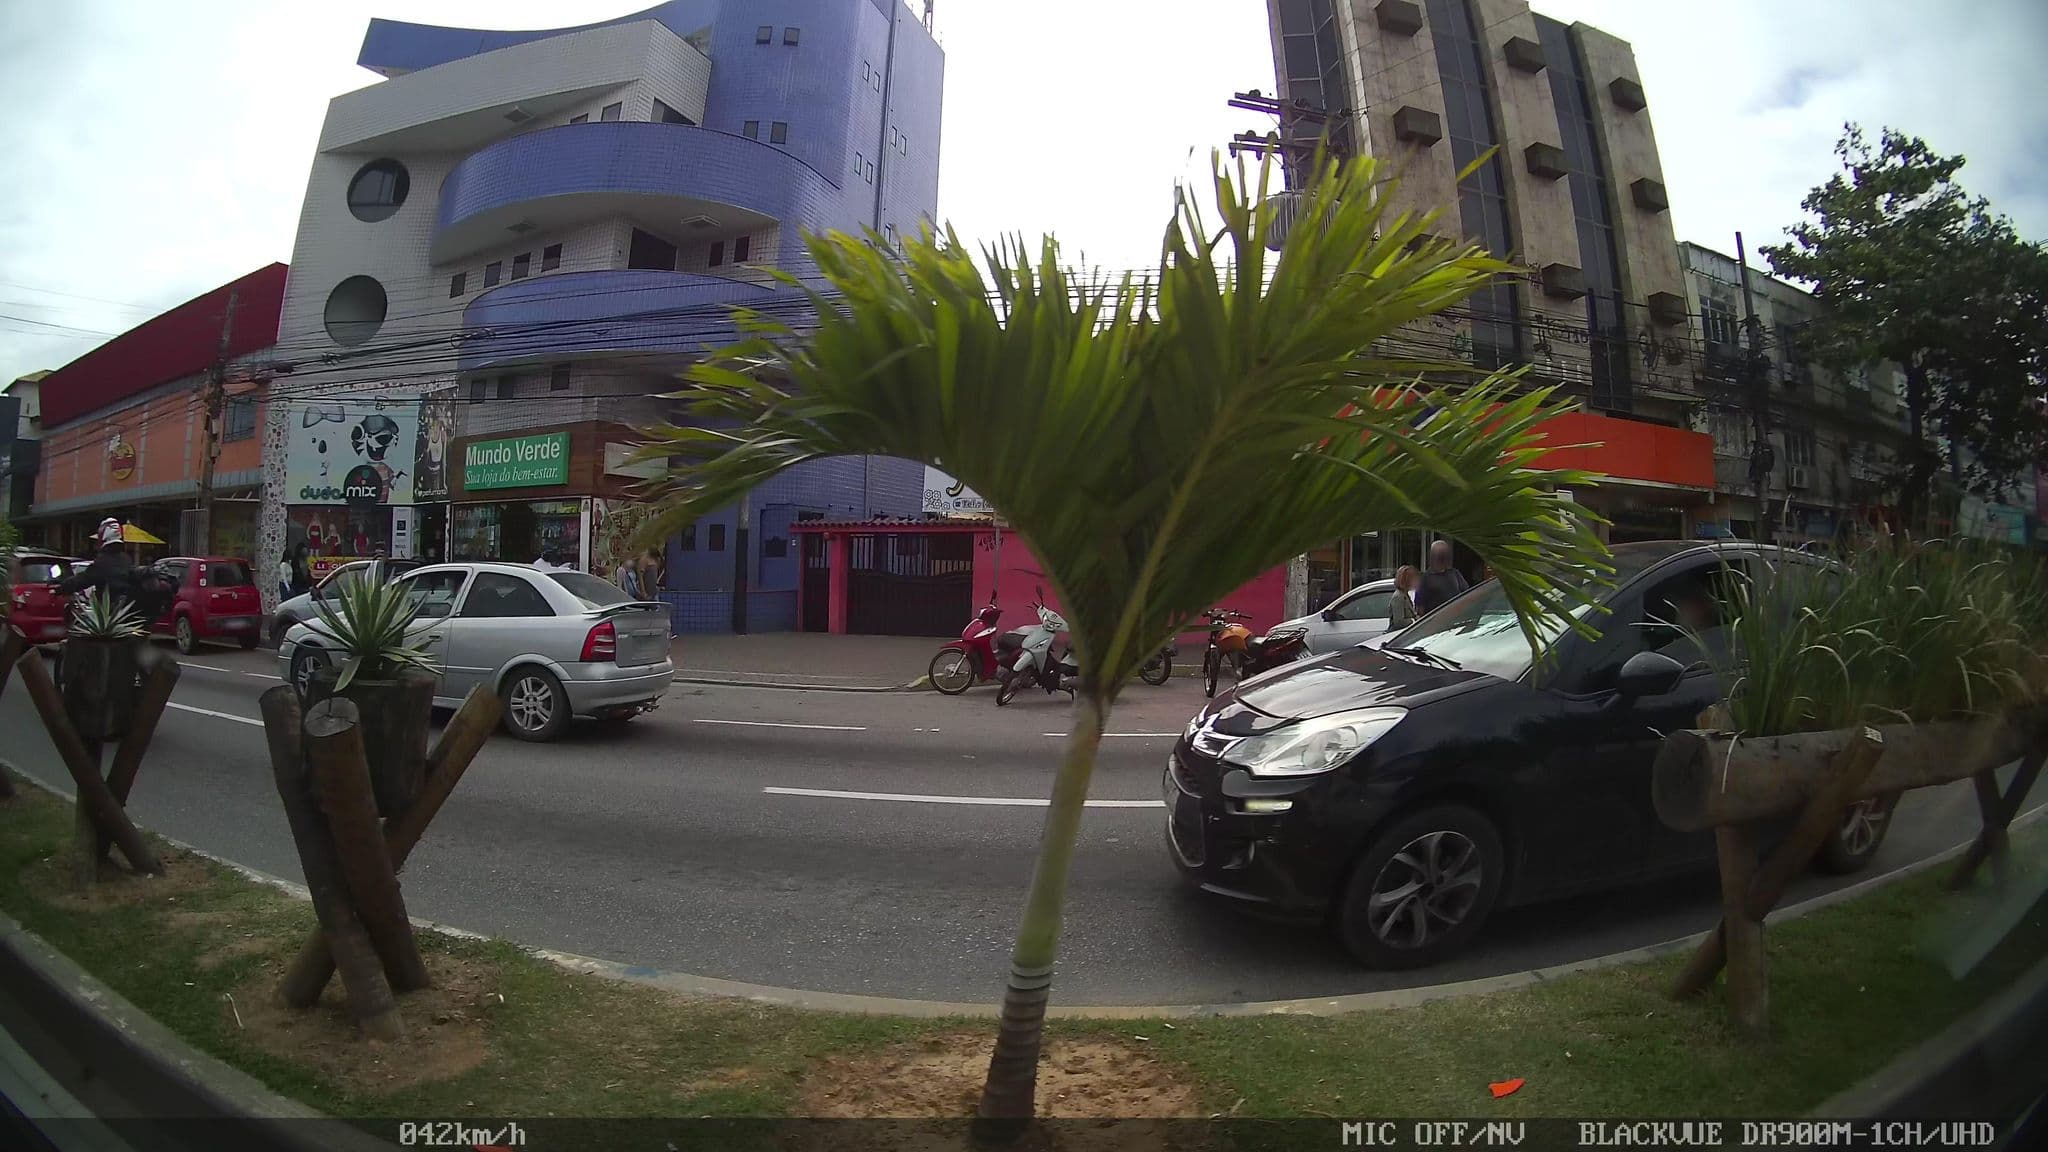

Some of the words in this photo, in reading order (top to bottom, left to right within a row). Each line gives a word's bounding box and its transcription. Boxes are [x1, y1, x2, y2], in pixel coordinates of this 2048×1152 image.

[465, 443, 511, 466] Mundo
[515, 437, 560, 462] Verde
[465, 470, 480, 485] Sua
[481, 468, 498, 487] loja
[500, 467, 511, 482] do
[512, 467, 558, 483] bem-estar.
[346, 486, 377, 498] mix
